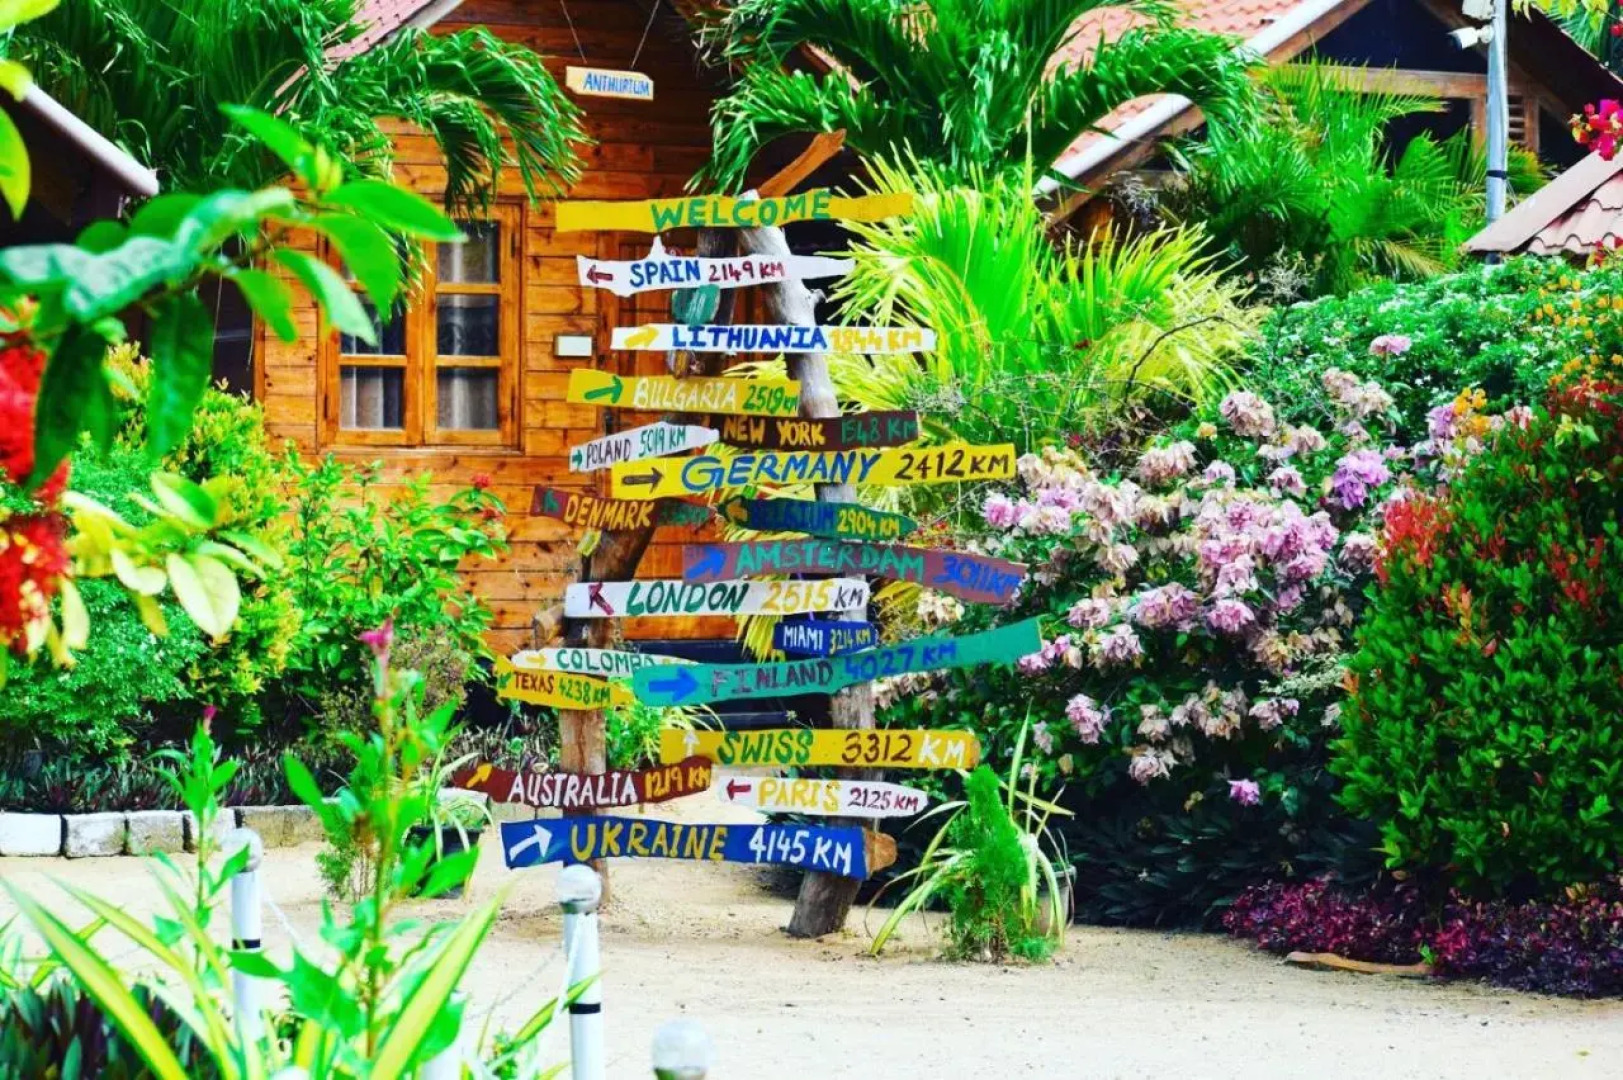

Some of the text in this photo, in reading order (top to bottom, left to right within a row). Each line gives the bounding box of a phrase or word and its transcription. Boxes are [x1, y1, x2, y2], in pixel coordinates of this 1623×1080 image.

[651, 193, 832, 229] WELCOME
[629, 259, 786, 287] SPAIN 2149 KM
[672, 326, 827, 349] LITHUANIA
[887, 330, 923, 350] KM
[633, 377, 737, 411] BULGARIA
[742, 384, 785, 414] 2519
[586, 438, 631, 468] POLAND
[669, 426, 686, 449] KM
[722, 416, 765, 443] NEW
[776, 420, 825, 446] YORK
[887, 417, 918, 440] KM
[681, 449, 1009, 491] GERMANY 2412 KM
[564, 493, 655, 530] DENMARK
[837, 509, 875, 538] 2904
[879, 517, 899, 537] KM
[735, 542, 924, 581] AMSTERDAM
[626, 580, 865, 615] LONDON 2515 KM
[782, 625, 823, 650] MIAMI
[855, 628, 872, 646] KM
[515, 670, 611, 704] TEXAS 4238 KM
[710, 641, 957, 697] FINLAND 4027 KM
[717, 730, 965, 767] SWISS 3312 KM
[508, 772, 638, 808] AUSTRALIA
[688, 763, 712, 787] KM
[758, 780, 919, 811] PARIS 2125 KM
[571, 821, 853, 874] UKRAINE 4145 KM
